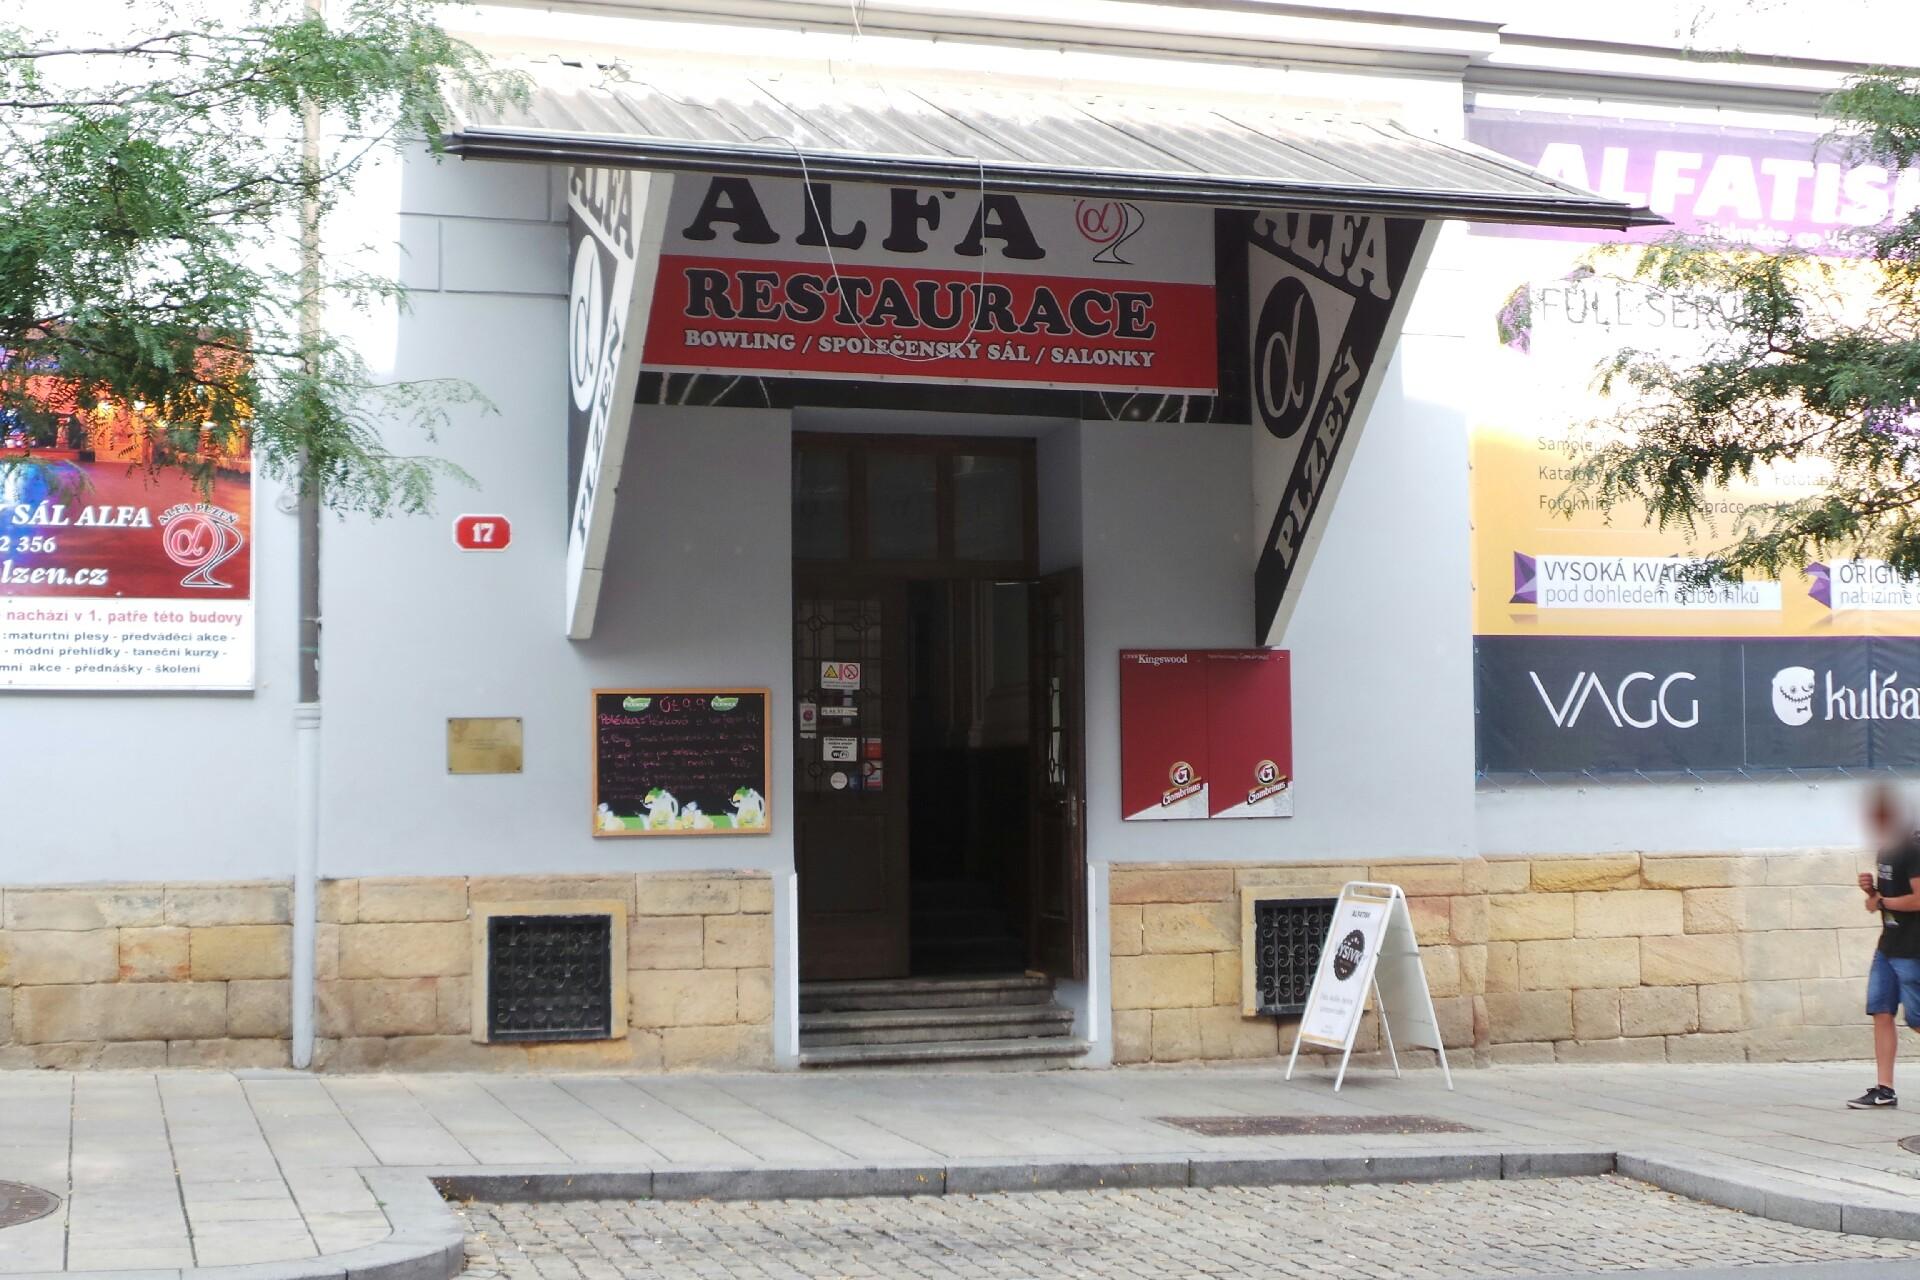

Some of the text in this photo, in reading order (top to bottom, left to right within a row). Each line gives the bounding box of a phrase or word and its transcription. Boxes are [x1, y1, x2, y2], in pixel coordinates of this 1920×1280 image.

[682, 176, 1046, 260] ALFA
[1253, 210, 1392, 300] ALFA
[684, 268, 1156, 339] RESTAURACE
[685, 330, 797, 353] BOWLING
[818, 333, 981, 362] SPOLEČENSKÝ
[988, 338, 1030, 363] SÁL
[1050, 347, 1156, 369] SALONKY
[12, 500, 153, 529] SÁL ALFA
[471, 523, 495, 543] 17
[16, 536, 56, 553] 356
[1, 560, 109, 586] lzen.cz
[1544, 558, 1627, 583] VYSOKÁ
[1546, 586, 1579, 607] pod
[1584, 585, 1669, 604] dohledem
[7, 609, 243, 627] nachází v 1. patře této budovy
[74, 631, 110, 643] plesy
[197, 633, 228, 642] akce
[13, 646, 54, 656] módní
[133, 647, 181, 657] taneční
[184, 647, 220, 659] kurzy
[1138, 653, 1188, 666] Kingswood
[29, 664, 62, 672] akce
[75, 663, 143, 675] přednášky
[155, 664, 201, 674] školení
